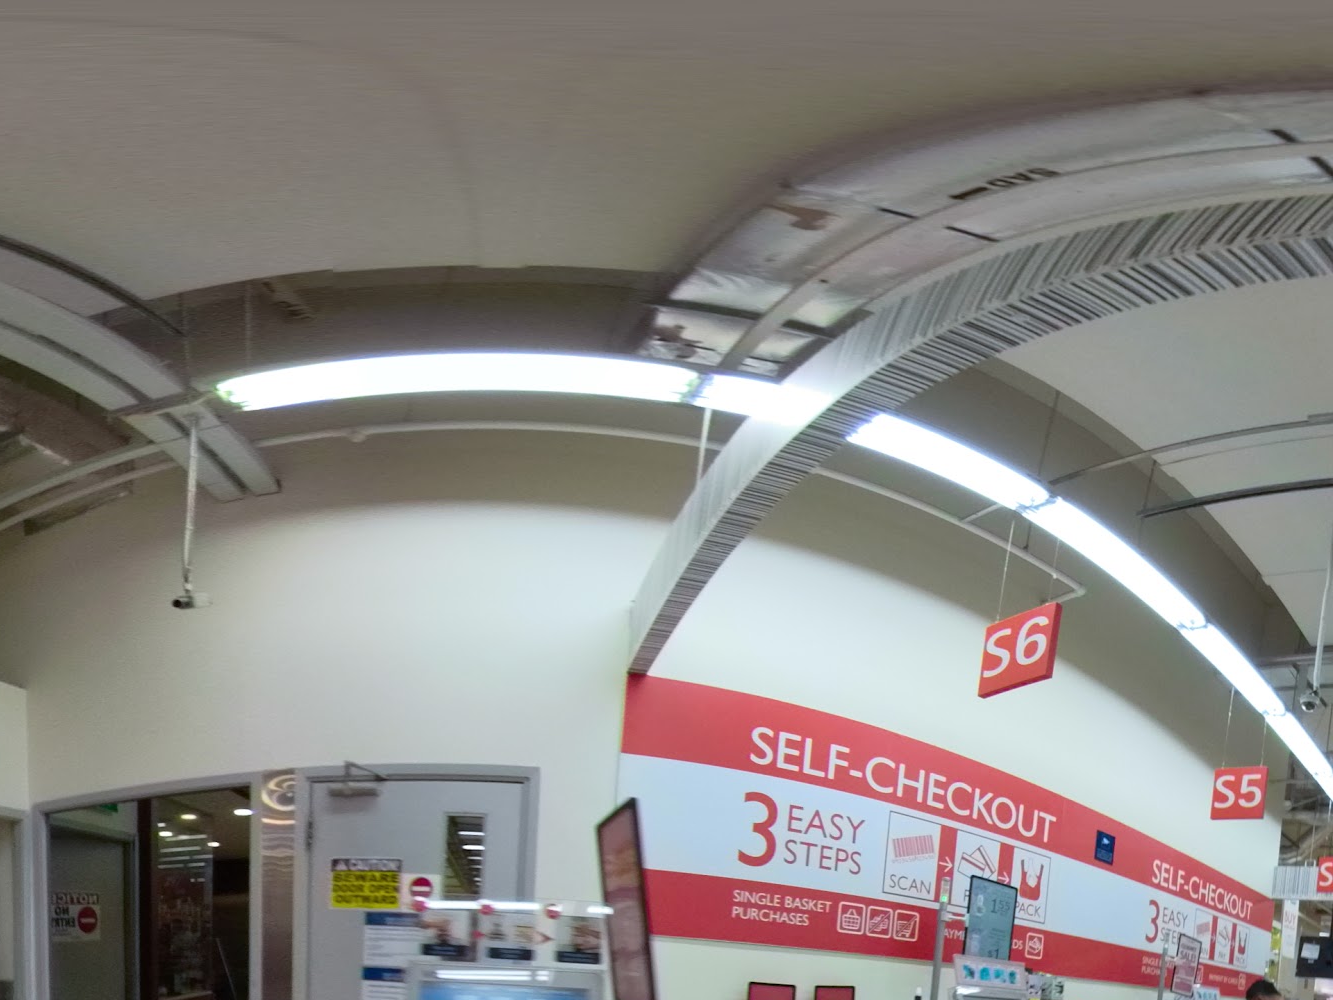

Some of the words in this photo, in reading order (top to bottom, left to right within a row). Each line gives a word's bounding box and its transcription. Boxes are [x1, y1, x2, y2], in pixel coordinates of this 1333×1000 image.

[986, 166, 1061, 191] SAD
[983, 616, 1049, 678] S6
[749, 726, 1057, 843] SELF-CHECKOUT
[1214, 774, 1262, 809] S5
[737, 791, 778, 867] 3
[787, 804, 865, 844] EASY
[783, 839, 862, 875] STEPS
[733, 890, 781, 907] SINGLE
[784, 896, 832, 913] BASKET
[889, 874, 931, 895] SCAN
[1152, 860, 1253, 920] SELF-CHECKOUT
[732, 907, 809, 926] PURCHASES
[1145, 899, 1160, 943] 3
[1162, 907, 1188, 928] EASY
